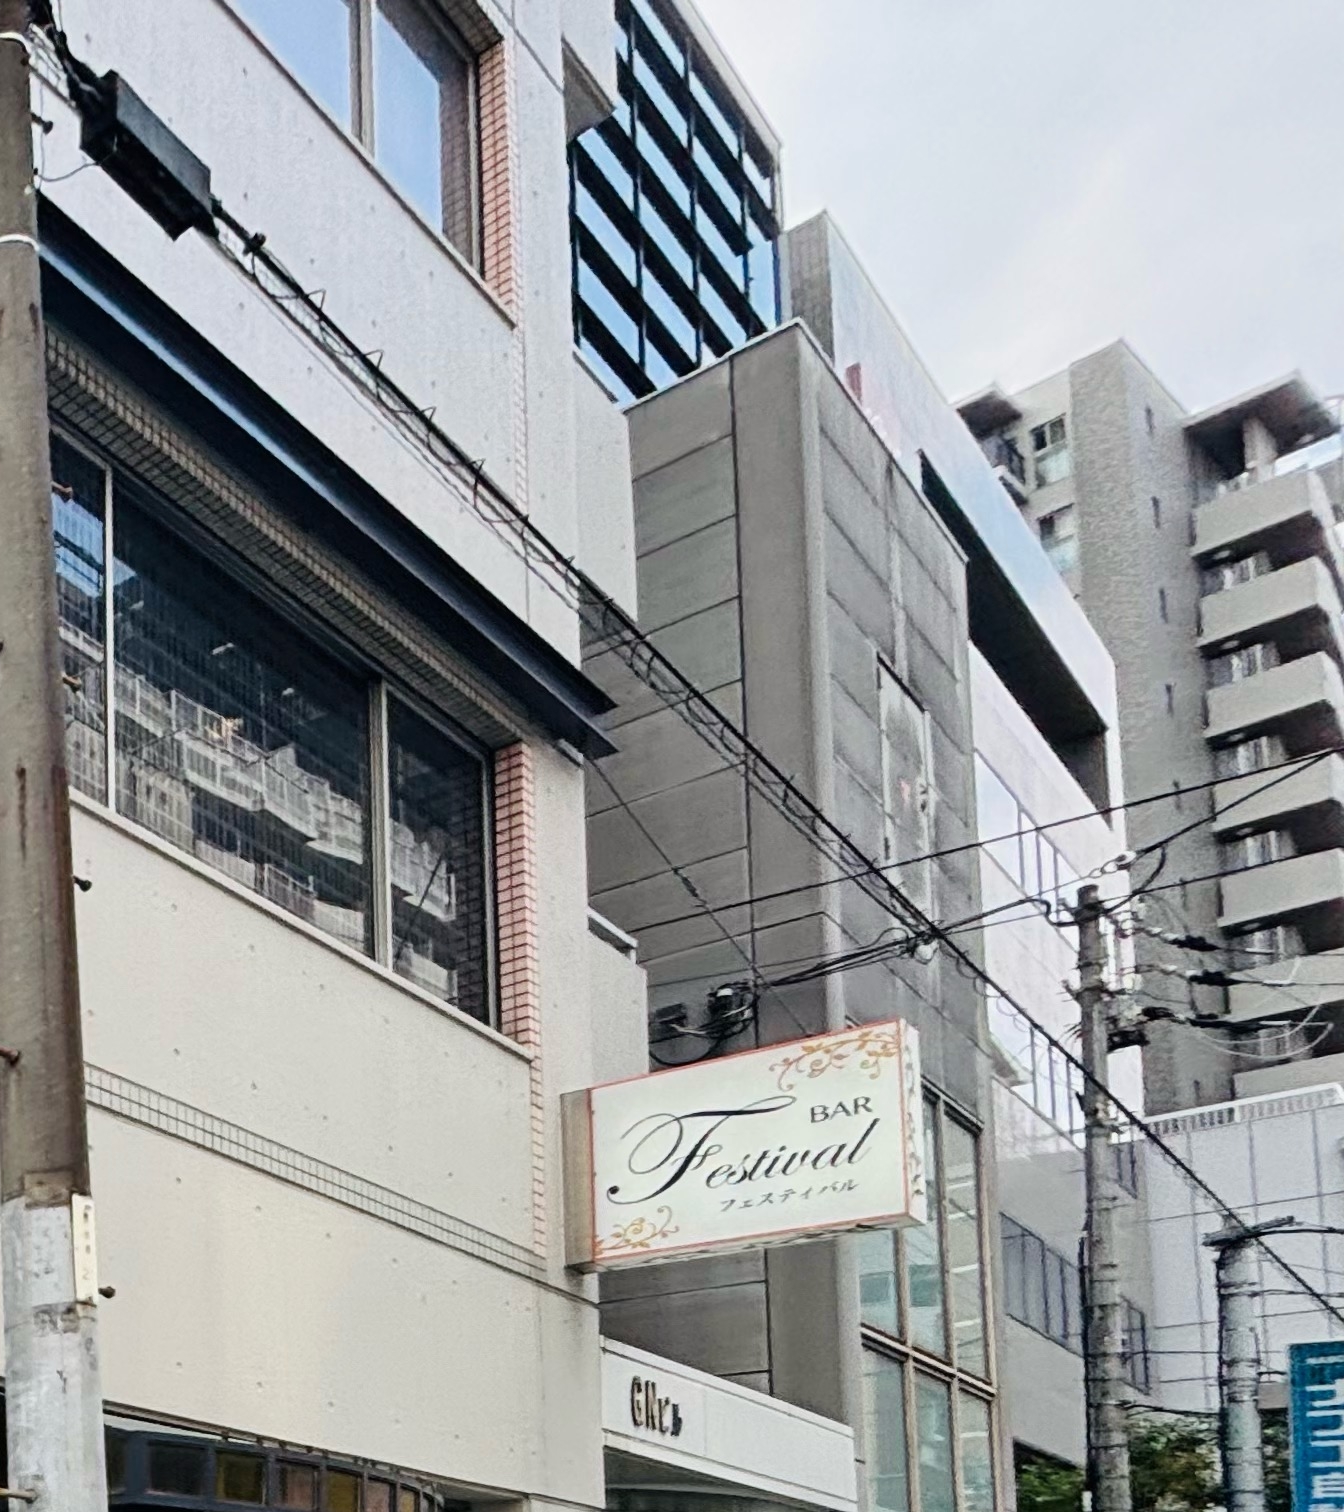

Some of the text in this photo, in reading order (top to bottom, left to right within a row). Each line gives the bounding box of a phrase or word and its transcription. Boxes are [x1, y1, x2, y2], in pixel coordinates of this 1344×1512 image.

[810, 1095, 874, 1124] BAR
[606, 1095, 881, 1205] Festival
[719, 1178, 860, 1213] フェスティバル
